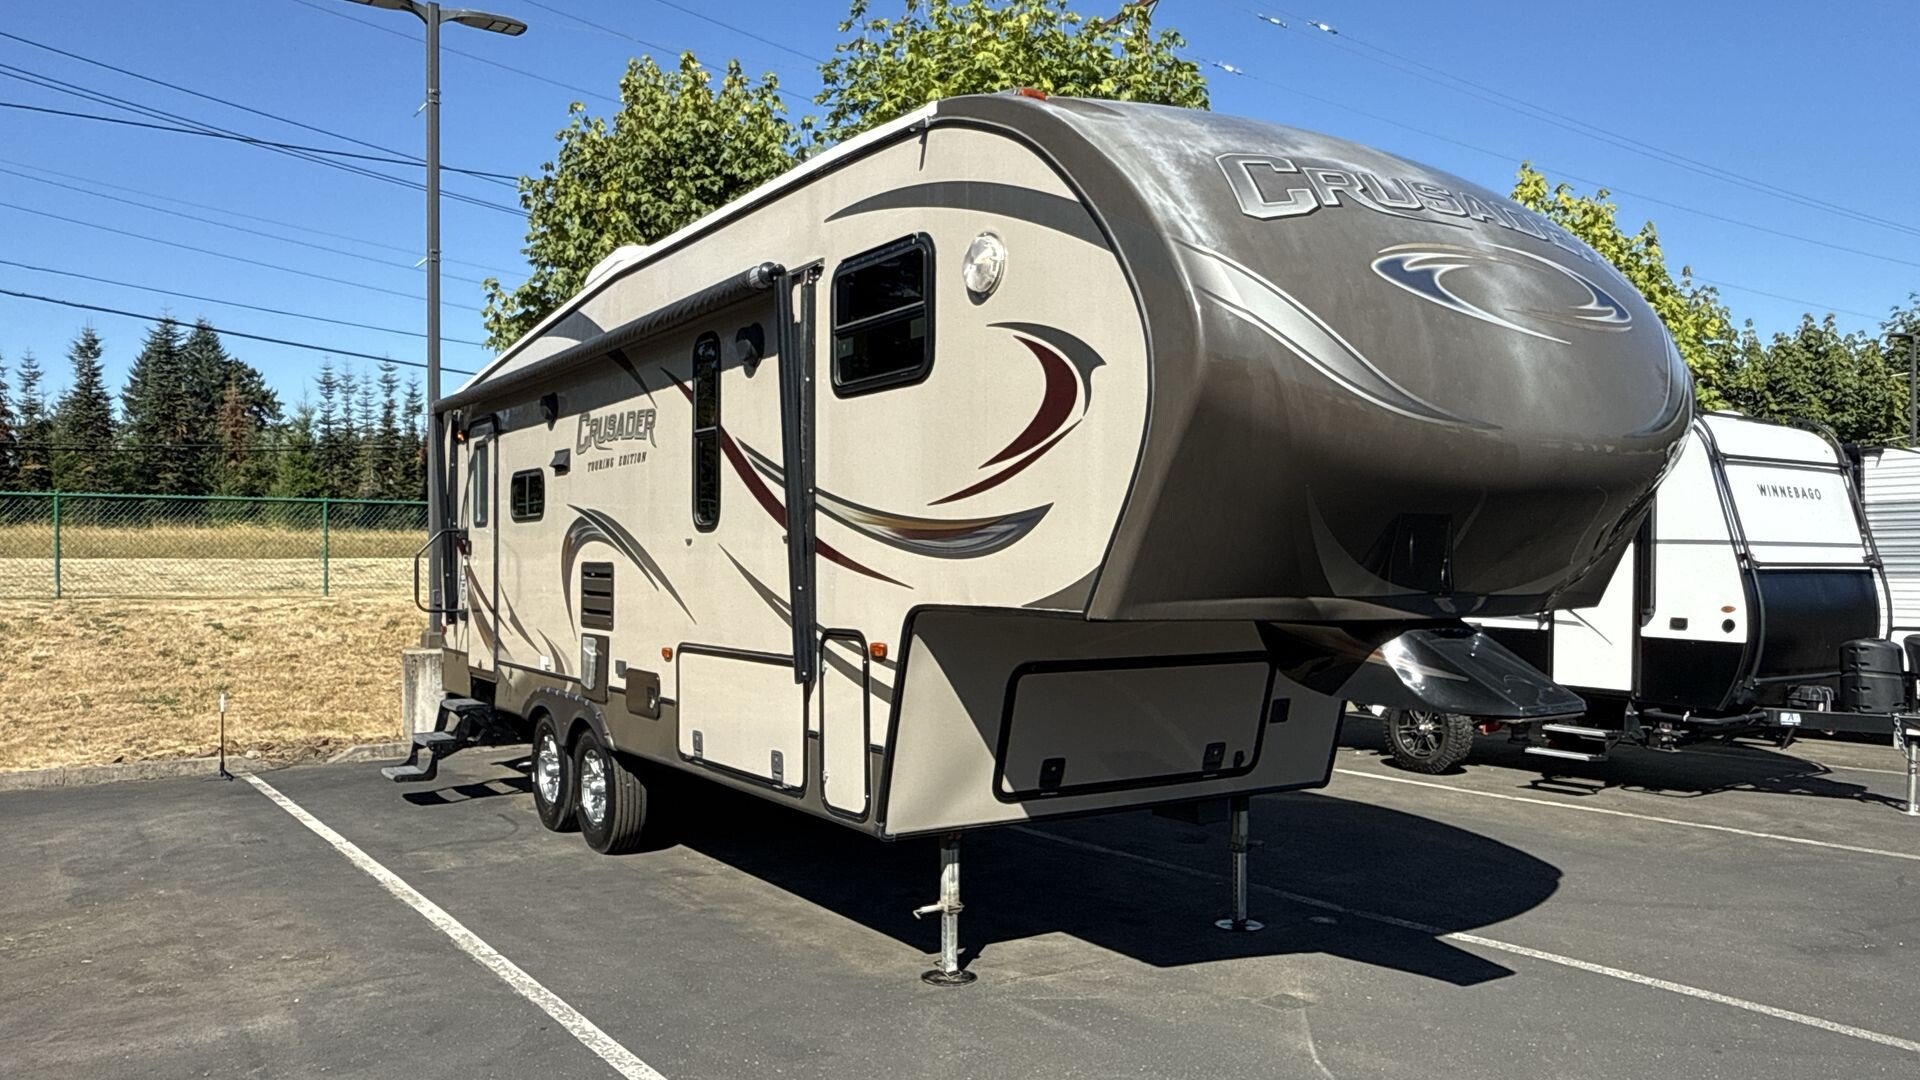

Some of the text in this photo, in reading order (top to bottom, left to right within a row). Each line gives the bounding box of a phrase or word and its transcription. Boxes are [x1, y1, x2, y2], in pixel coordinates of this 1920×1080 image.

[576, 408, 657, 455] CRUSADER
[587, 451, 647, 473] TOURING EDITION
[1756, 483, 1822, 501] WINNEBAGO
